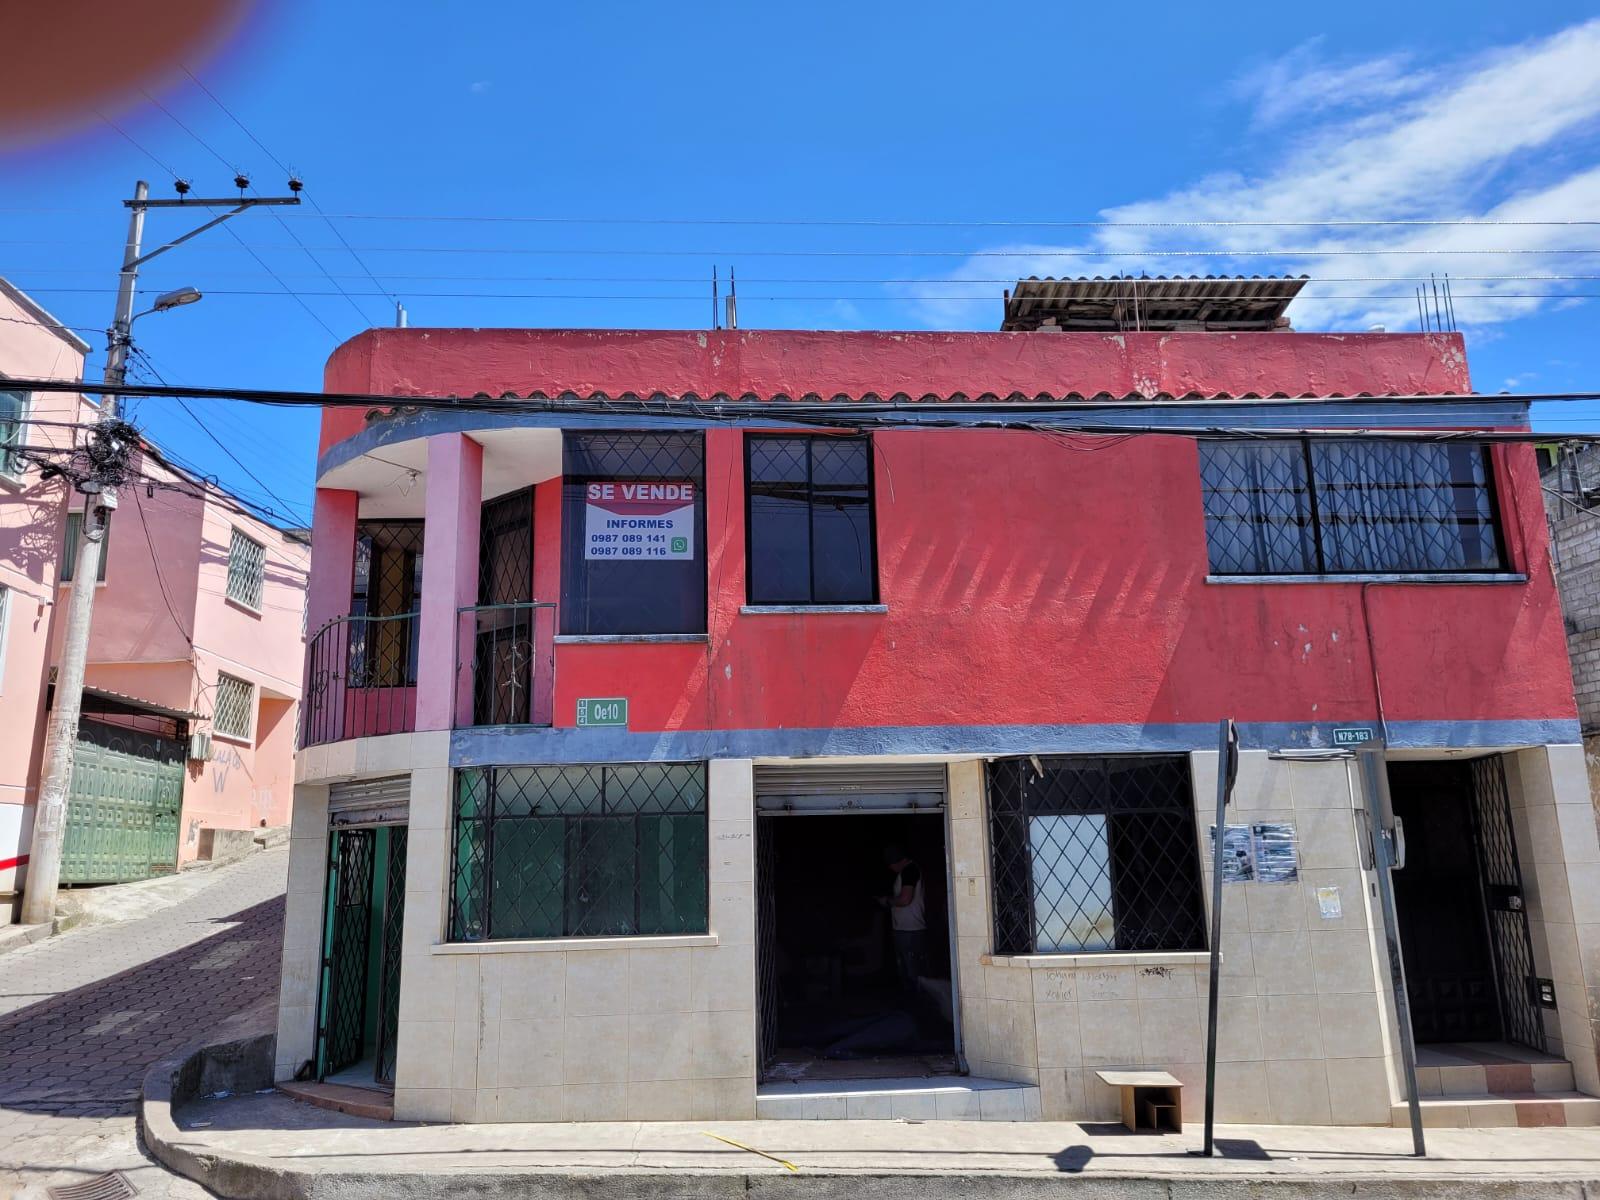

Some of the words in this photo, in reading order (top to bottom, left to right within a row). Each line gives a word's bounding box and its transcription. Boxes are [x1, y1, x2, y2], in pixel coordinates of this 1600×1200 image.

[588, 484, 615, 500] SE
[621, 484, 693, 500] VENDE
[606, 520, 674, 529] INFORMES
[591, 534, 618, 542] 0987
[622, 534, 642, 542] 089
[646, 534, 665, 542] 141
[591, 547, 618, 555] 0987
[622, 547, 642, 555] 089
[646, 547, 666, 555] 116
